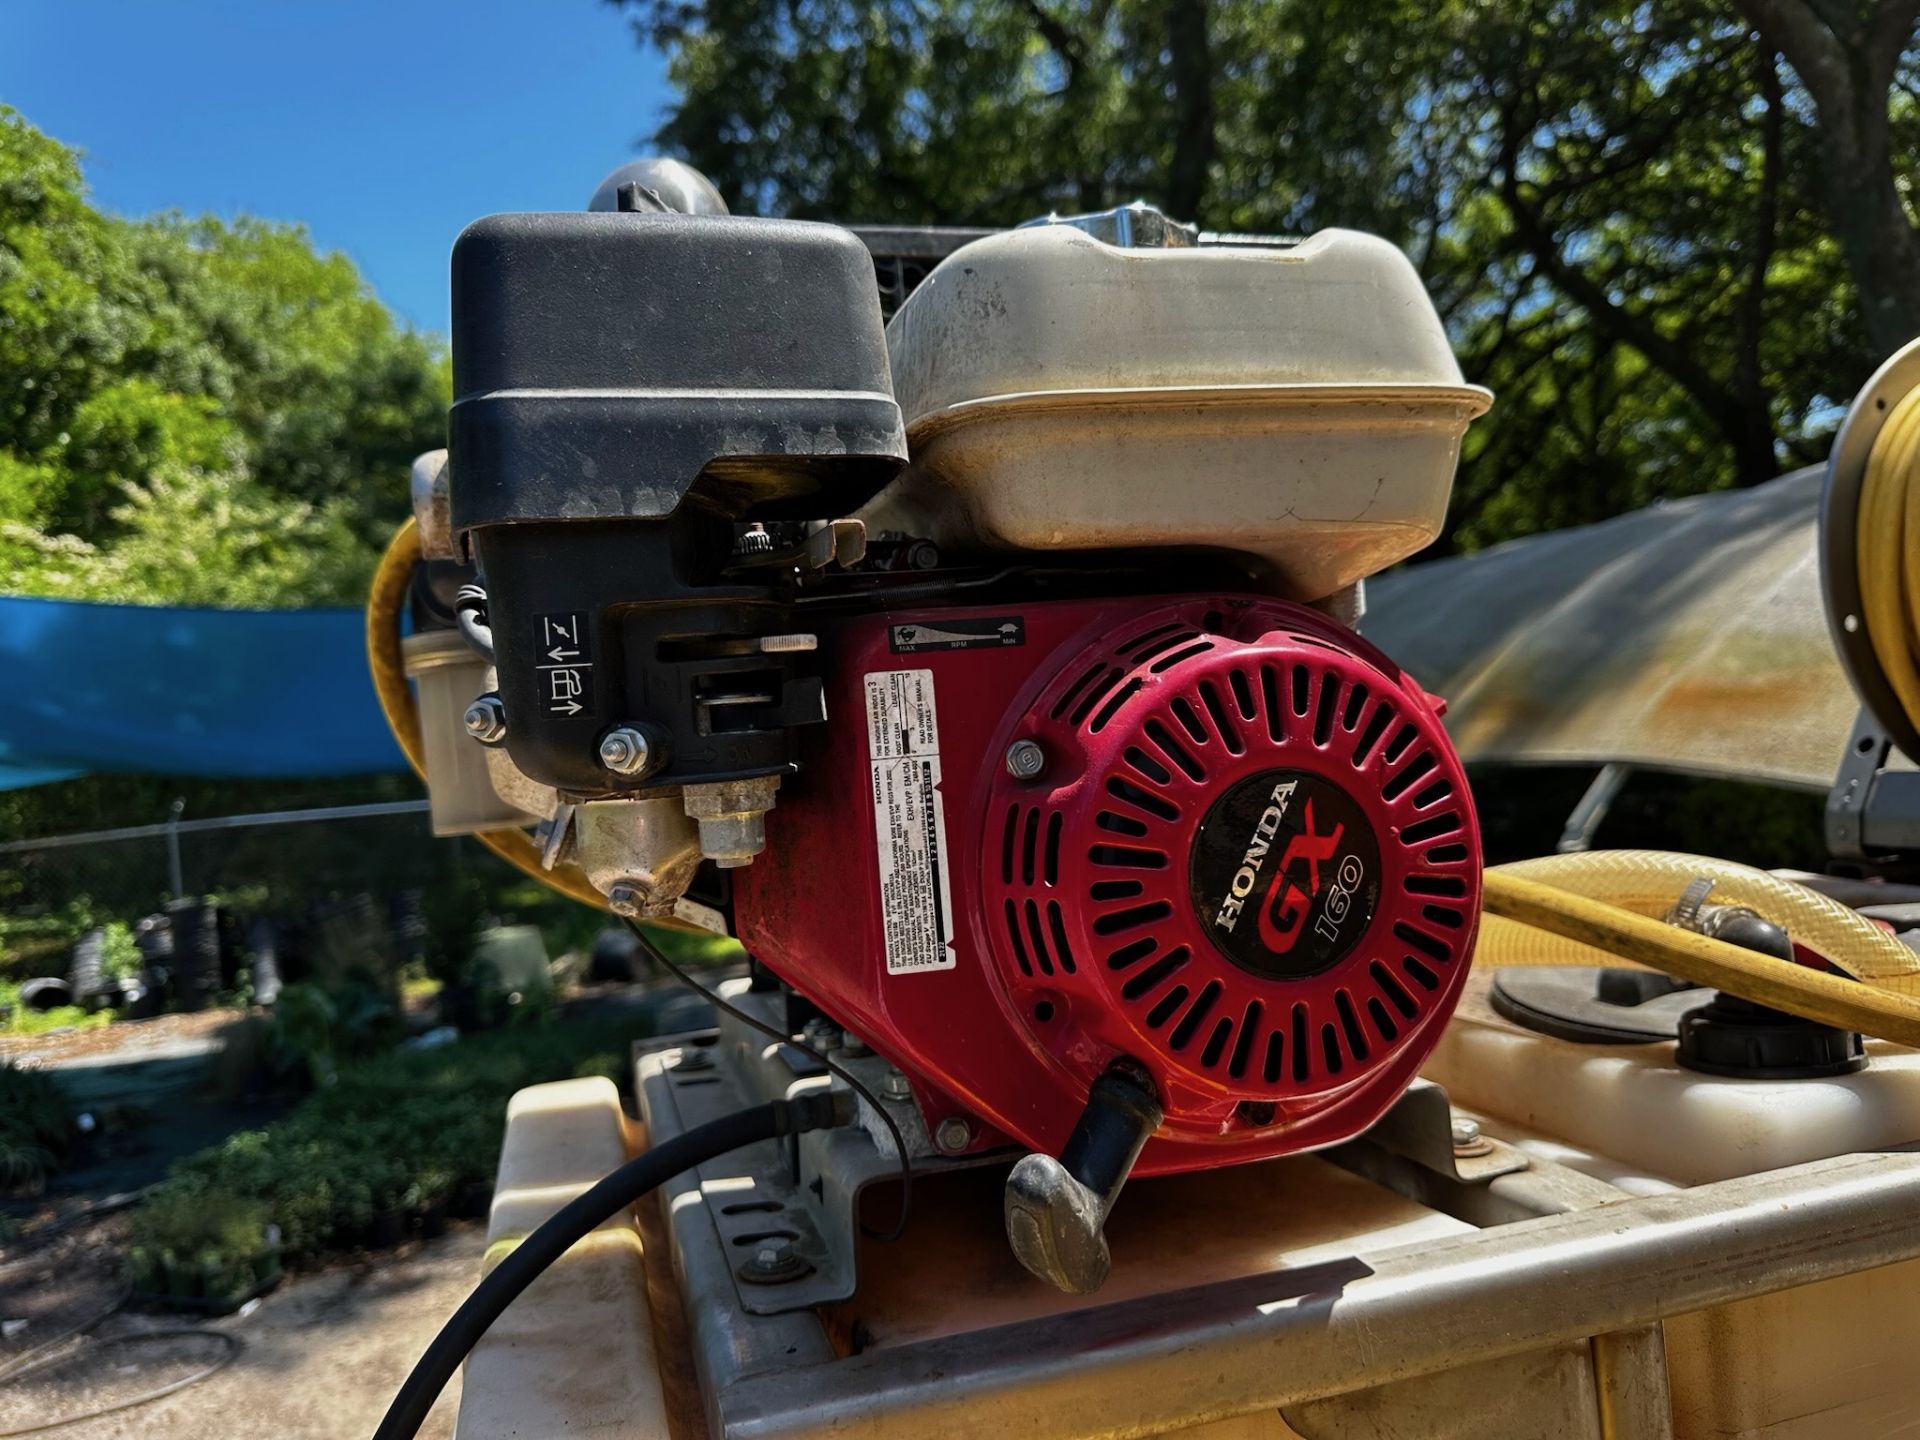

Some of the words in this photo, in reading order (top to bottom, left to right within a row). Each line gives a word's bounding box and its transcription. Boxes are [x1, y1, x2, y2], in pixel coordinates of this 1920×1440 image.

[873, 766, 881, 804] HONDA
[902, 761, 911, 786] EM/CM
[905, 790, 914, 820] EXH/EVP
[903, 829, 911, 868] SPECIFICATIONS
[1215, 779, 1298, 933] HONDA
[906, 870, 914, 906] MAINTENANCE
[1257, 796, 1345, 954] GX
[883, 882, 891, 917] INFORMATION
[1315, 855, 1364, 942] 160
